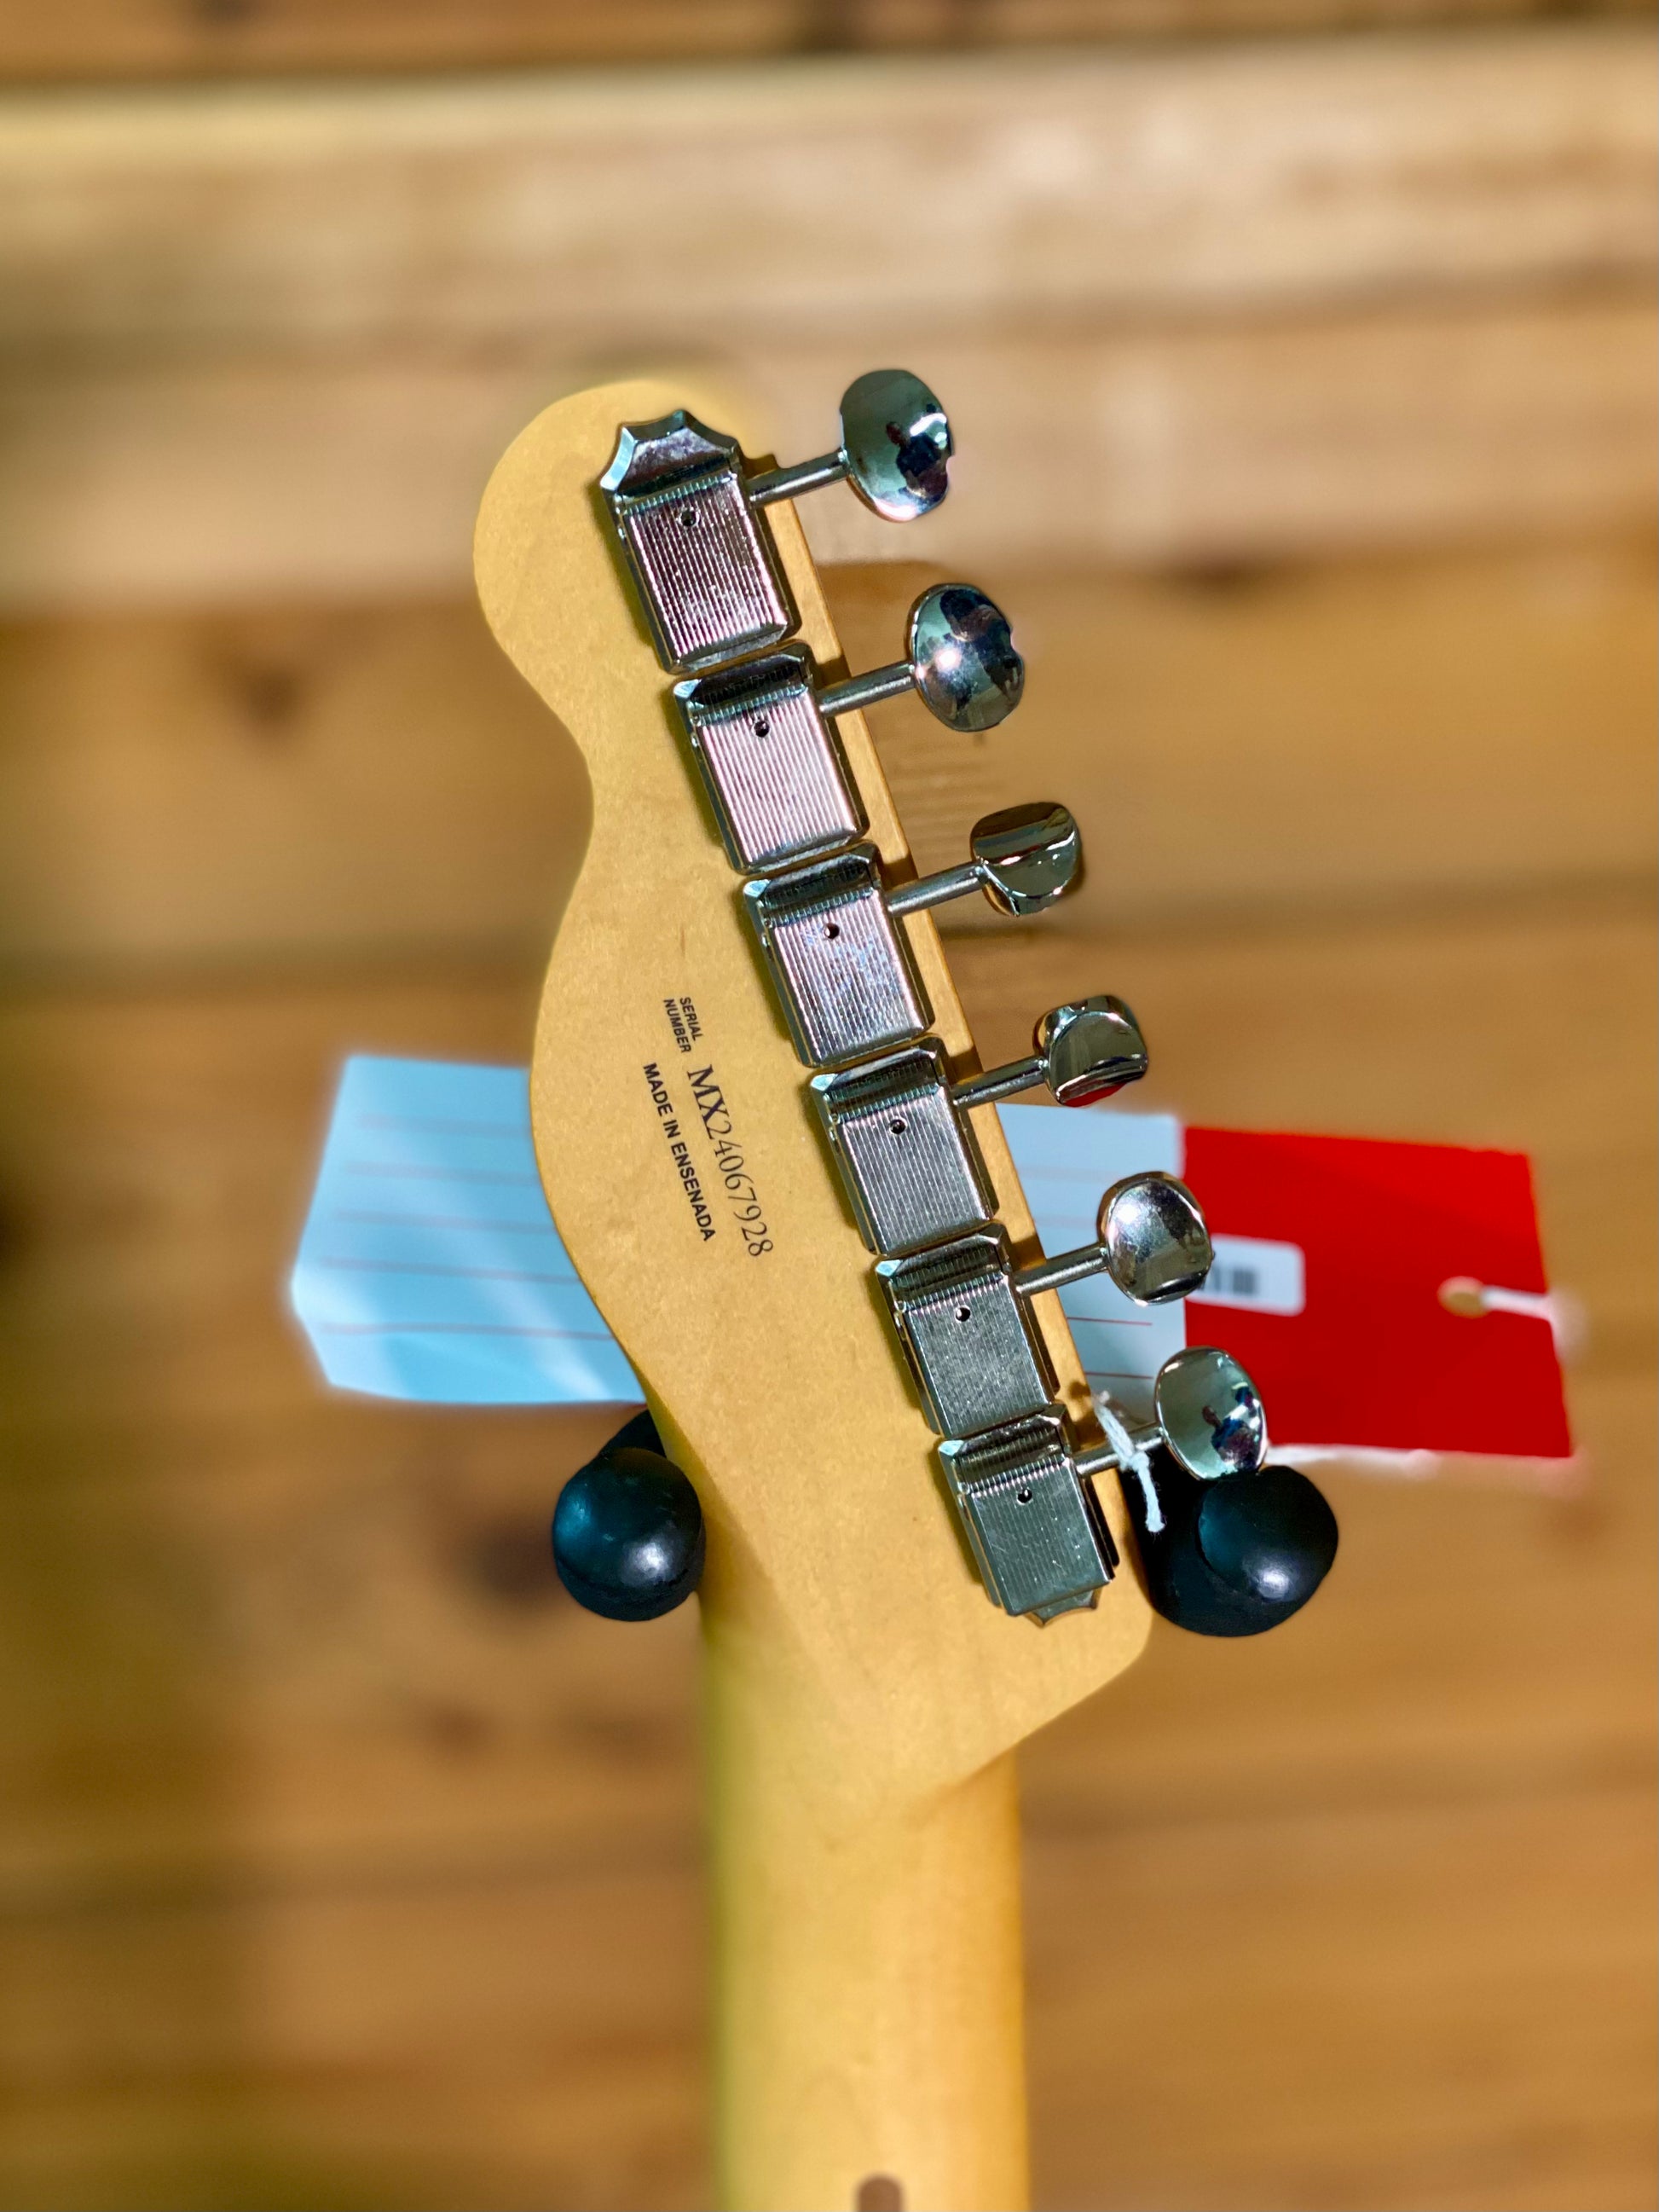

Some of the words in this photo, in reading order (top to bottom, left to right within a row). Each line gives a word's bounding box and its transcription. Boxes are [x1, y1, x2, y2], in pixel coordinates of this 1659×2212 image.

[663, 999, 692, 1053] NUMBER
[679, 996, 703, 1041] SERIAL
[643, 1062, 673, 1117] MADE
[663, 1119, 681, 1138] IN
[686, 1063, 774, 1258] MX24067928
[670, 1141, 716, 1242] ENSENADA
